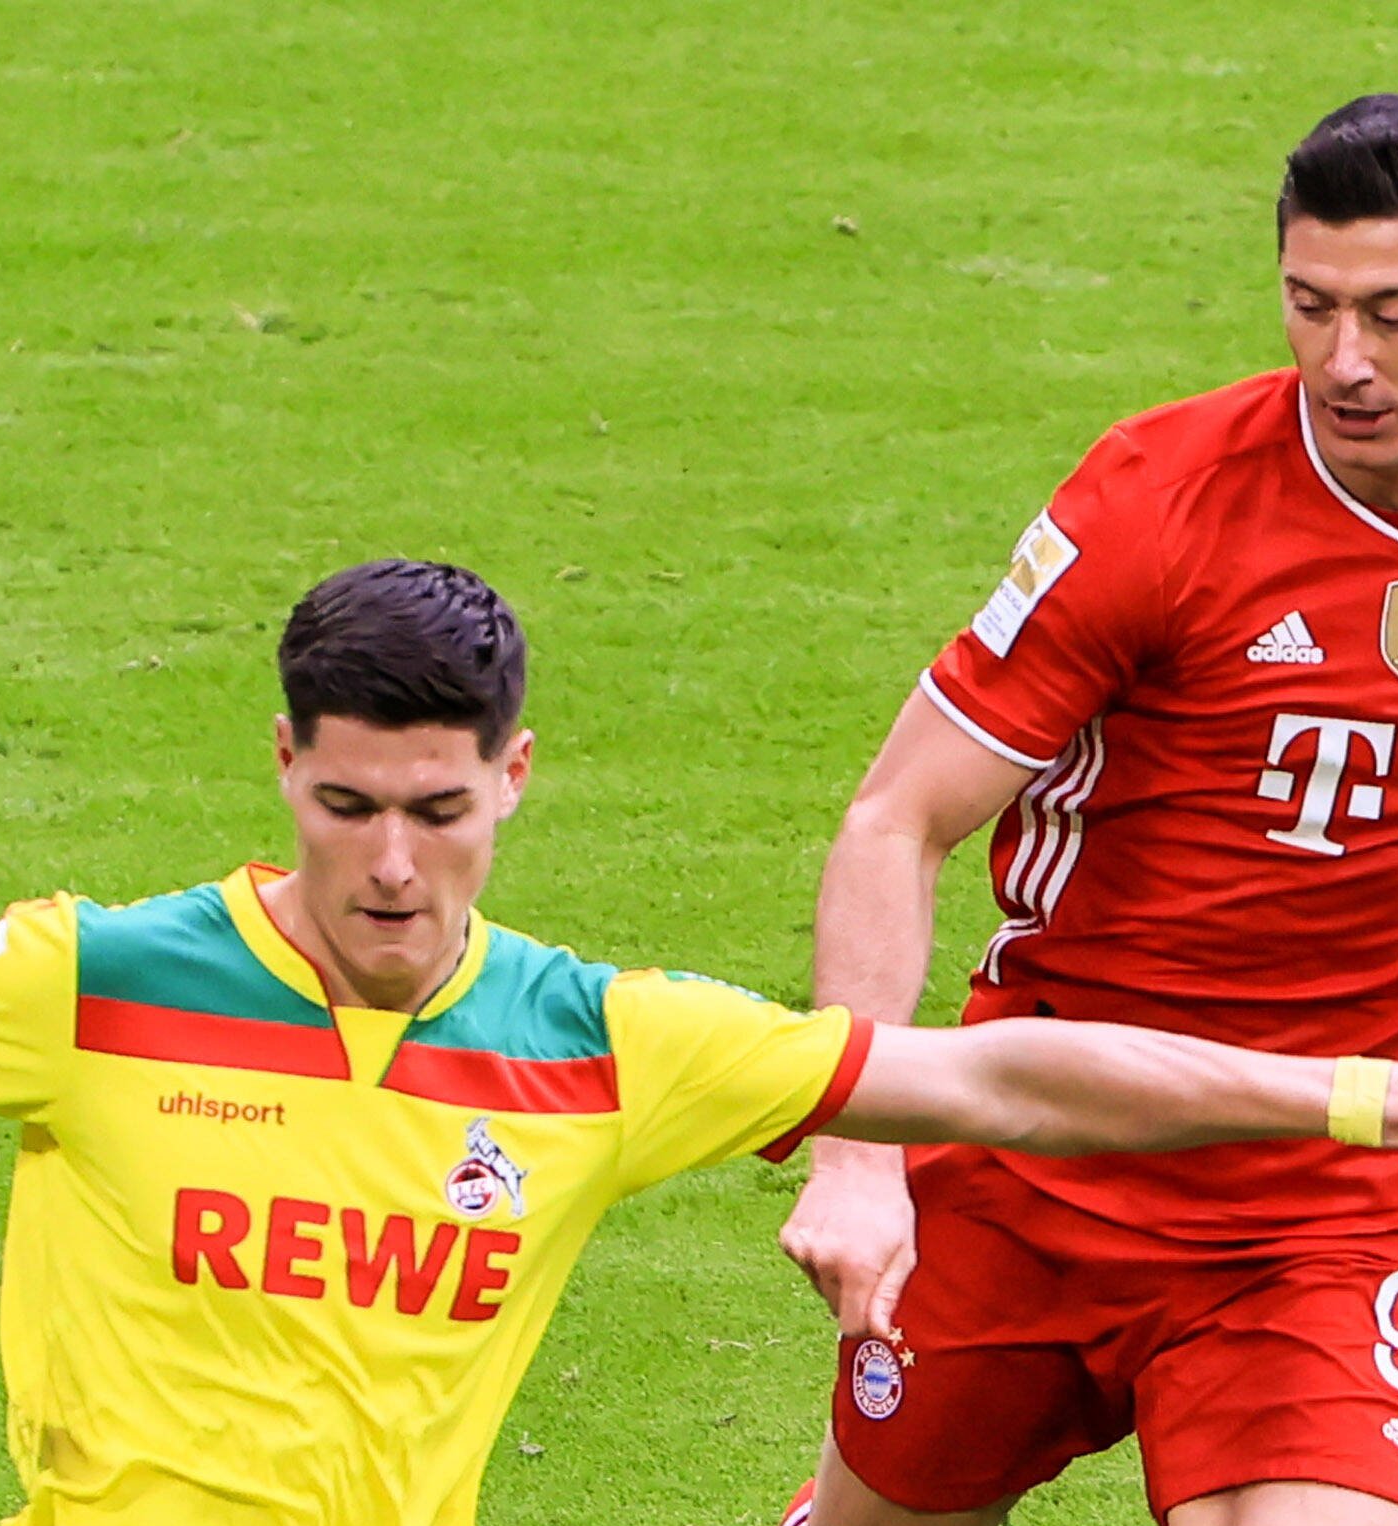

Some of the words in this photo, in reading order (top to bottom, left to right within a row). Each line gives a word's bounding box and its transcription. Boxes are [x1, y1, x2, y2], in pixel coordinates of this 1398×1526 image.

[1246, 643, 1324, 665] adidas
[158, 1091, 285, 1126] uhlsport
[172, 1187, 522, 1322] REWE
